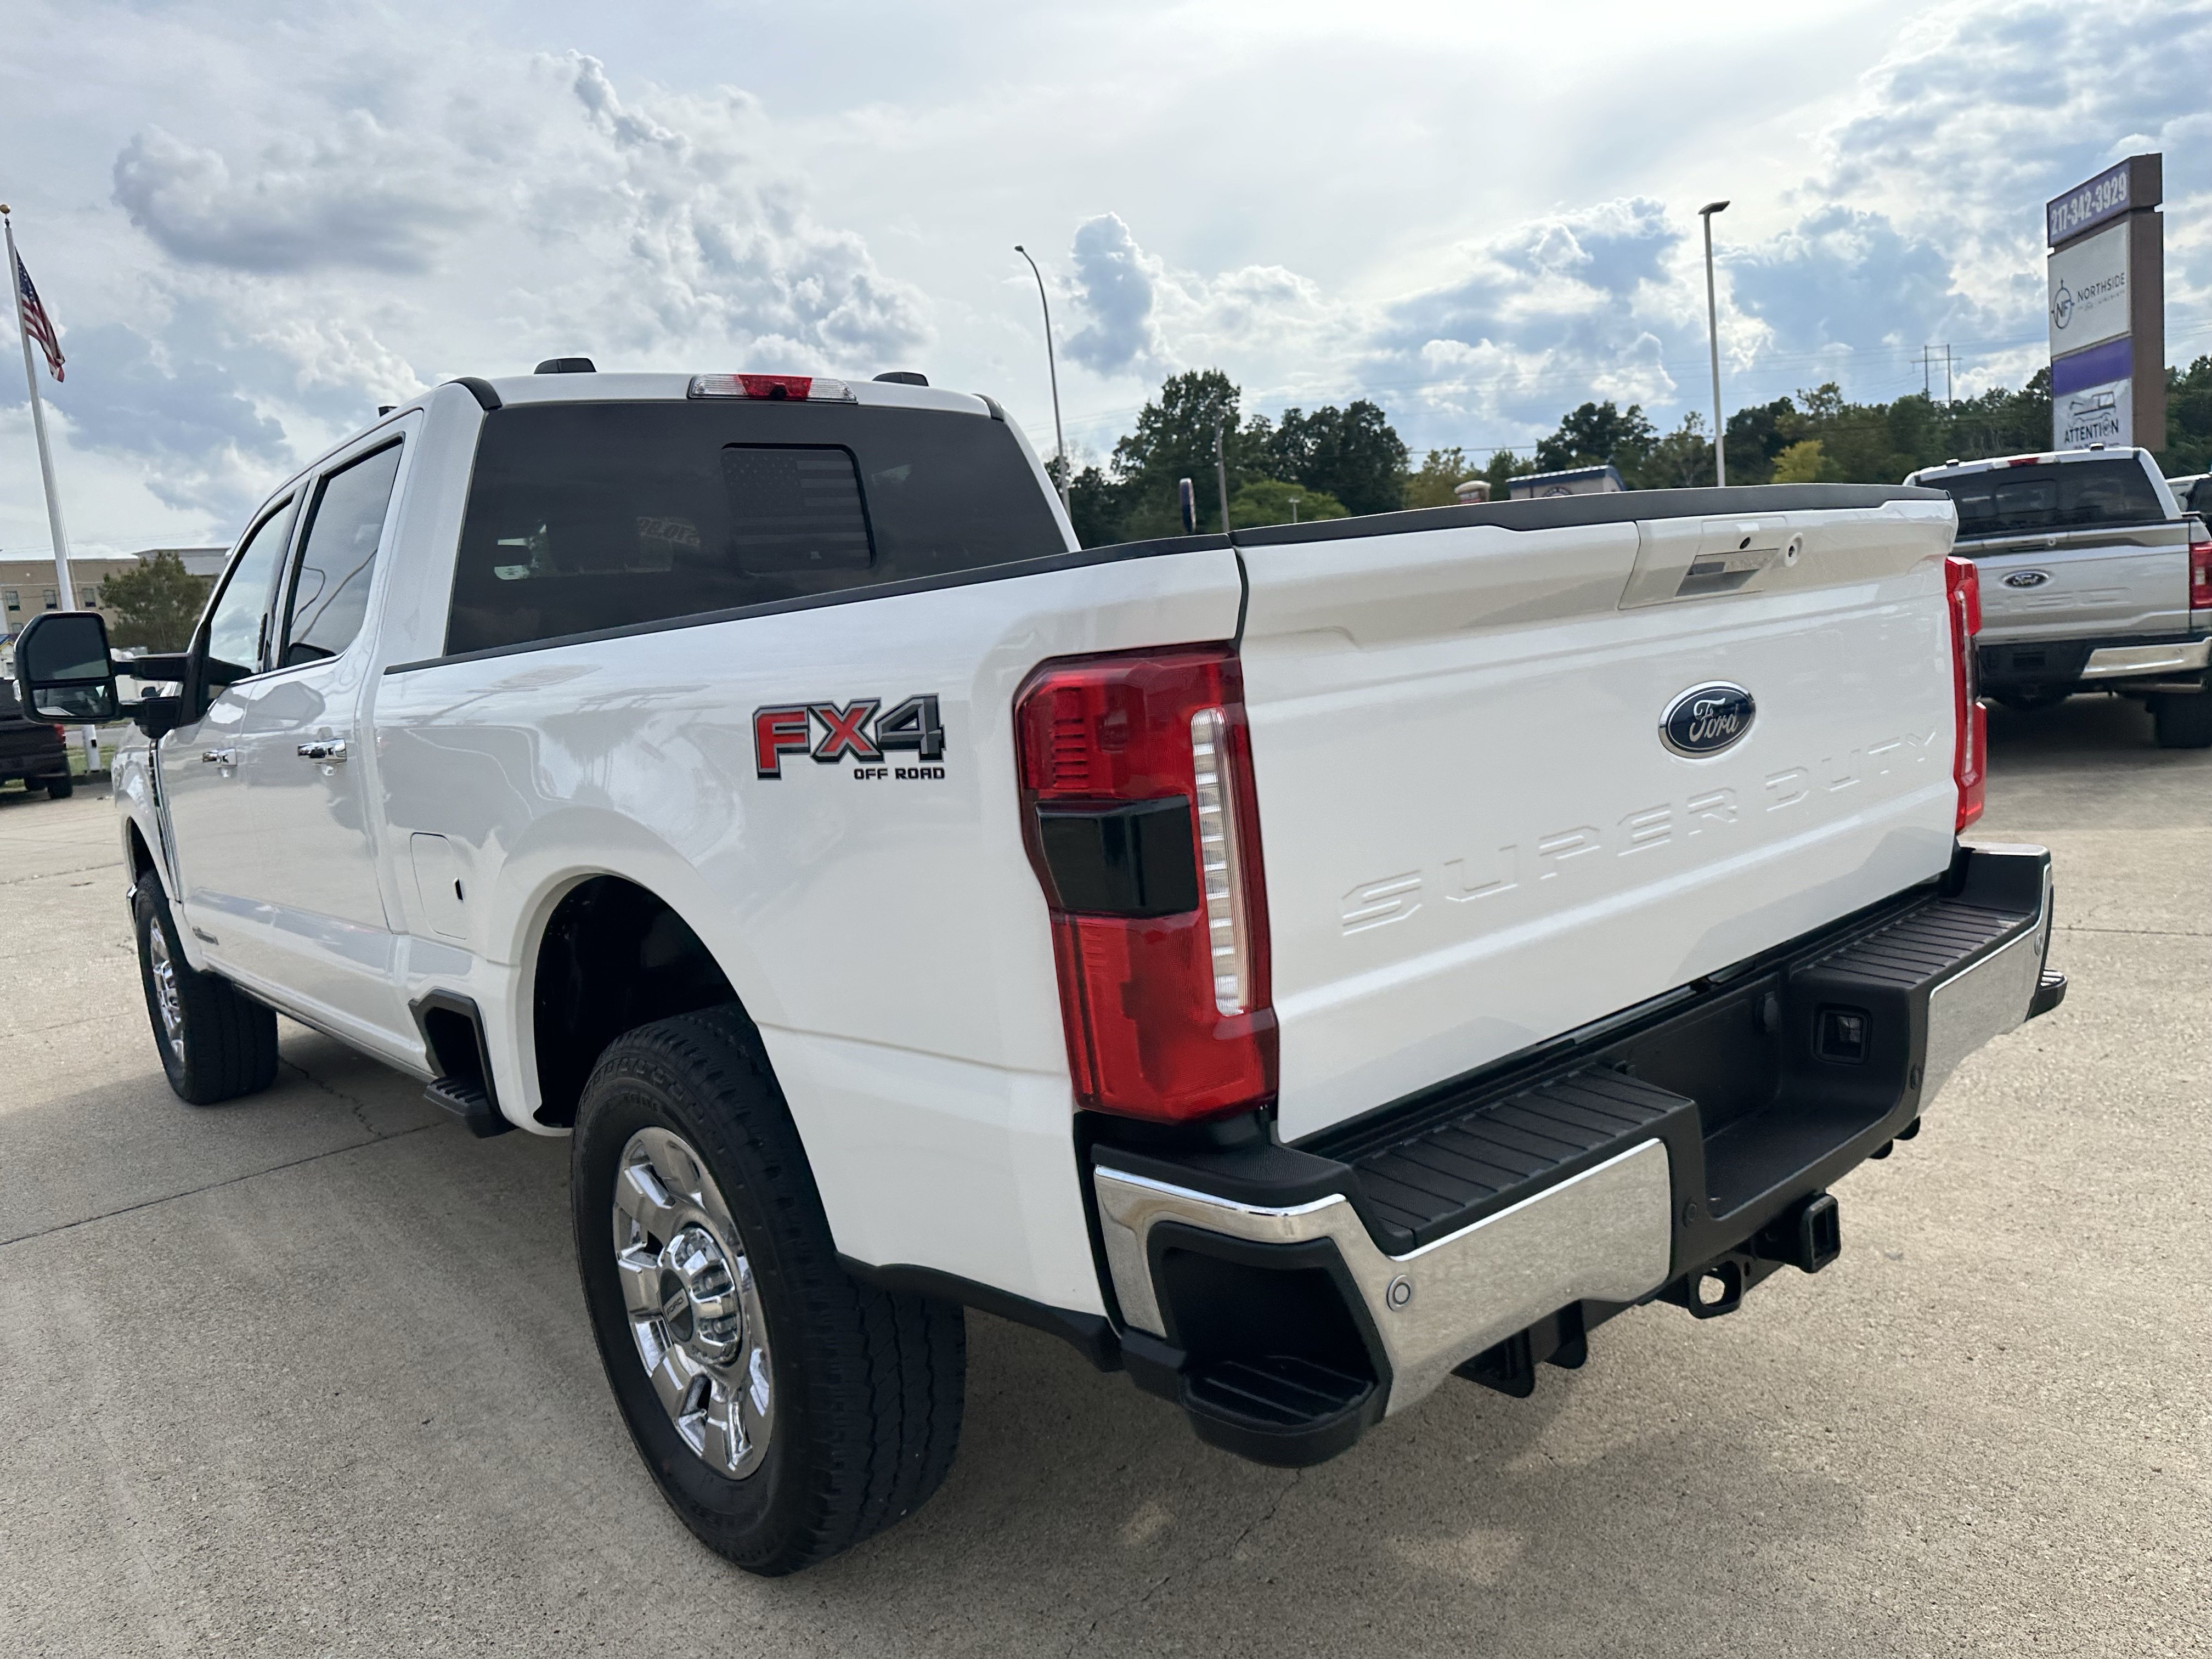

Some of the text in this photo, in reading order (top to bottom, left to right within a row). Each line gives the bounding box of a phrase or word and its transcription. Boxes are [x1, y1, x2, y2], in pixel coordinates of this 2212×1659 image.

[2051, 172, 2127, 235] 217-342-3929
[2077, 272, 2125, 302] NORTHSIDE
[2064, 419, 2119, 443] ATTENTION
[752, 692, 946, 780] FX4
[1689, 697, 1740, 742] Ford
[854, 767, 945, 780] OFF ROAD
[1342, 725, 1938, 936] SUPER DUTY
[666, 1296, 684, 1316] FORD
